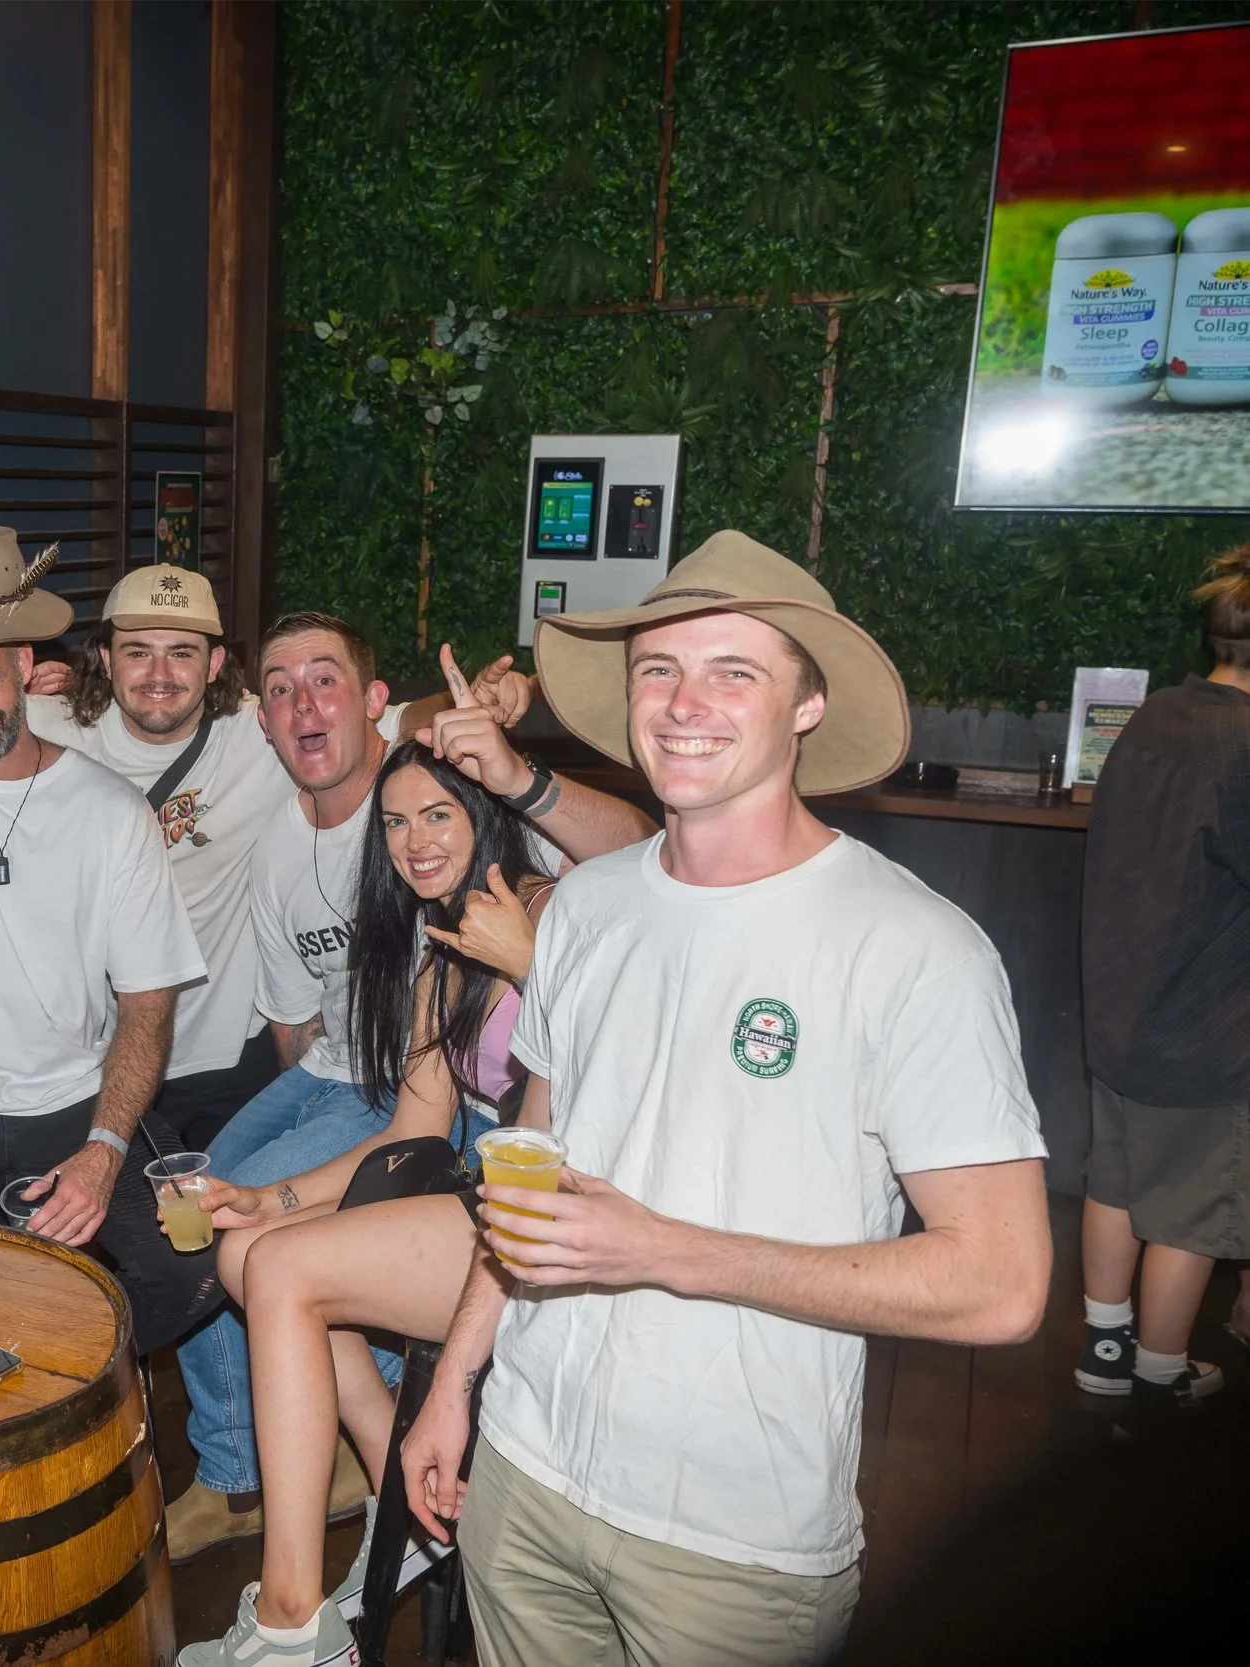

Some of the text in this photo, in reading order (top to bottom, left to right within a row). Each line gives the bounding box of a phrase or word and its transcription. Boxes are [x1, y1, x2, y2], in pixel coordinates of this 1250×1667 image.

[1198, 279, 1248, 291] Nature's
[1070, 288, 1118, 300] Nature's
[1188, 296, 1215, 306] HIGH
[1091, 302, 1152, 314] STRENGTH
[1206, 307, 1228, 315] VITA
[1079, 313, 1145, 323] VITA GUMMIES
[1194, 318, 1249, 335] Collag
[1080, 327, 1129, 341] Sleep
[295, 920, 358, 959] SSEN
[742, 1003, 761, 1022] NORTH
[738, 1027, 791, 1049] Hawaiian
[735, 1045, 759, 1072] PREMIUM
[758, 1058, 789, 1075] SURFING
